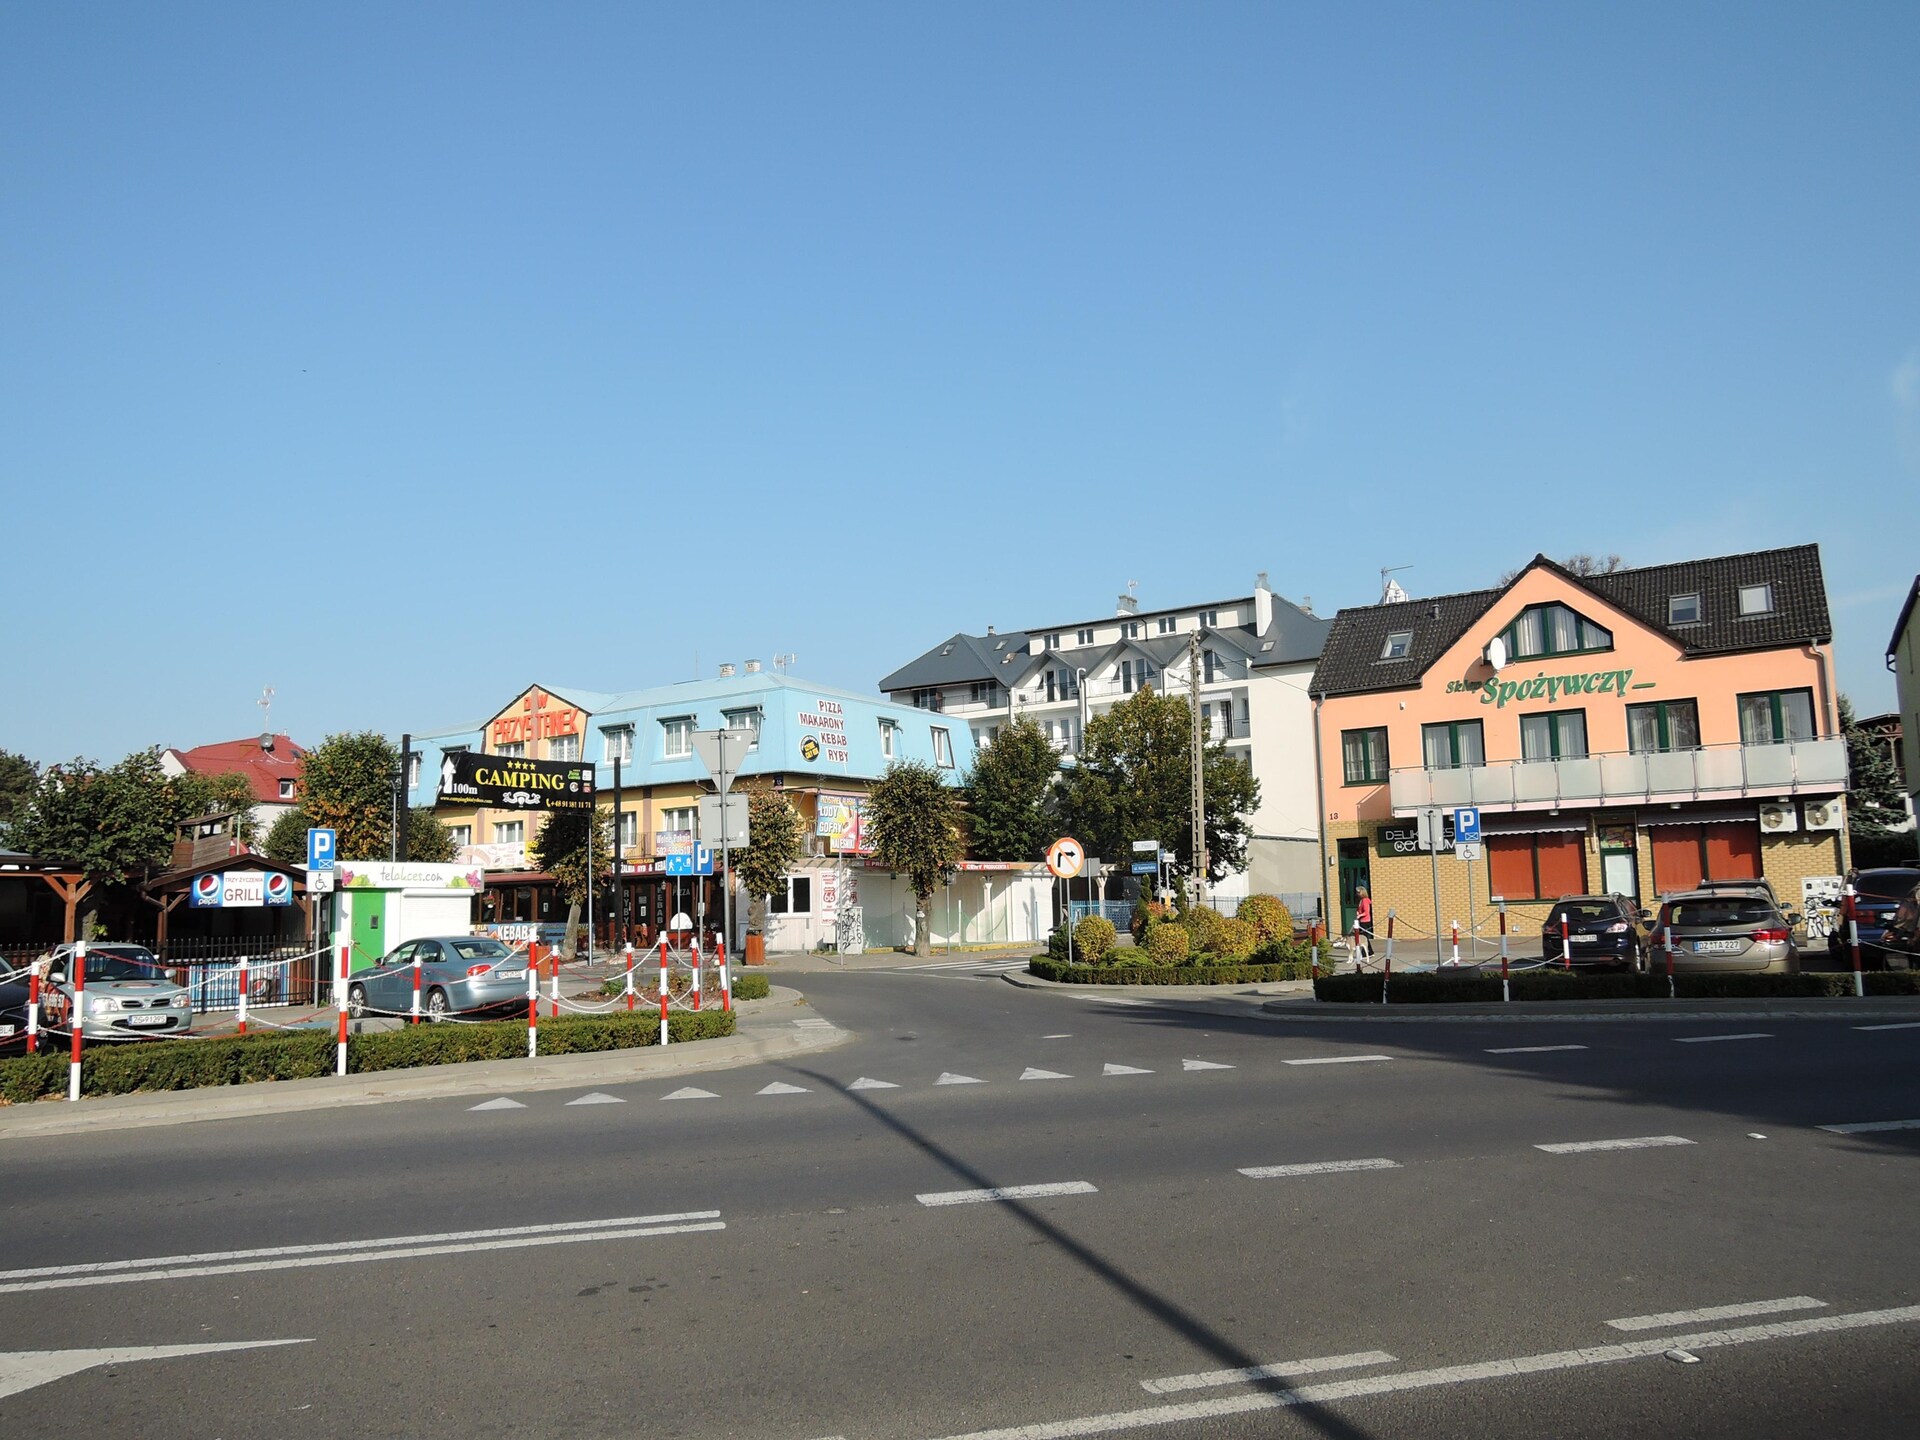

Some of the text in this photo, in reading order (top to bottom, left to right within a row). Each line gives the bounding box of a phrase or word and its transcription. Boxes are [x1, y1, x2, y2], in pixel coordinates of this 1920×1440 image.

[1480, 668, 1633, 709] Spożywczy
[818, 700, 843, 714] PIZZA
[493, 708, 579, 744] PRZYSTANEK
[799, 713, 844, 730] MAKARONY
[820, 732, 847, 746] KEBAB
[827, 749, 849, 762] RYBY
[475, 767, 565, 790] CAMPING
[453, 783, 478, 795] 100m
[820, 806, 838, 818] LODY
[1459, 810, 1475, 833] P
[314, 832, 330, 859] P
[198, 898, 218, 906] pepsi
[224, 888, 263, 902] GRILL
[268, 897, 287, 905] pepsi
[497, 925, 529, 941] KEBAB
[1698, 940, 1739, 950] DZ TA 227
